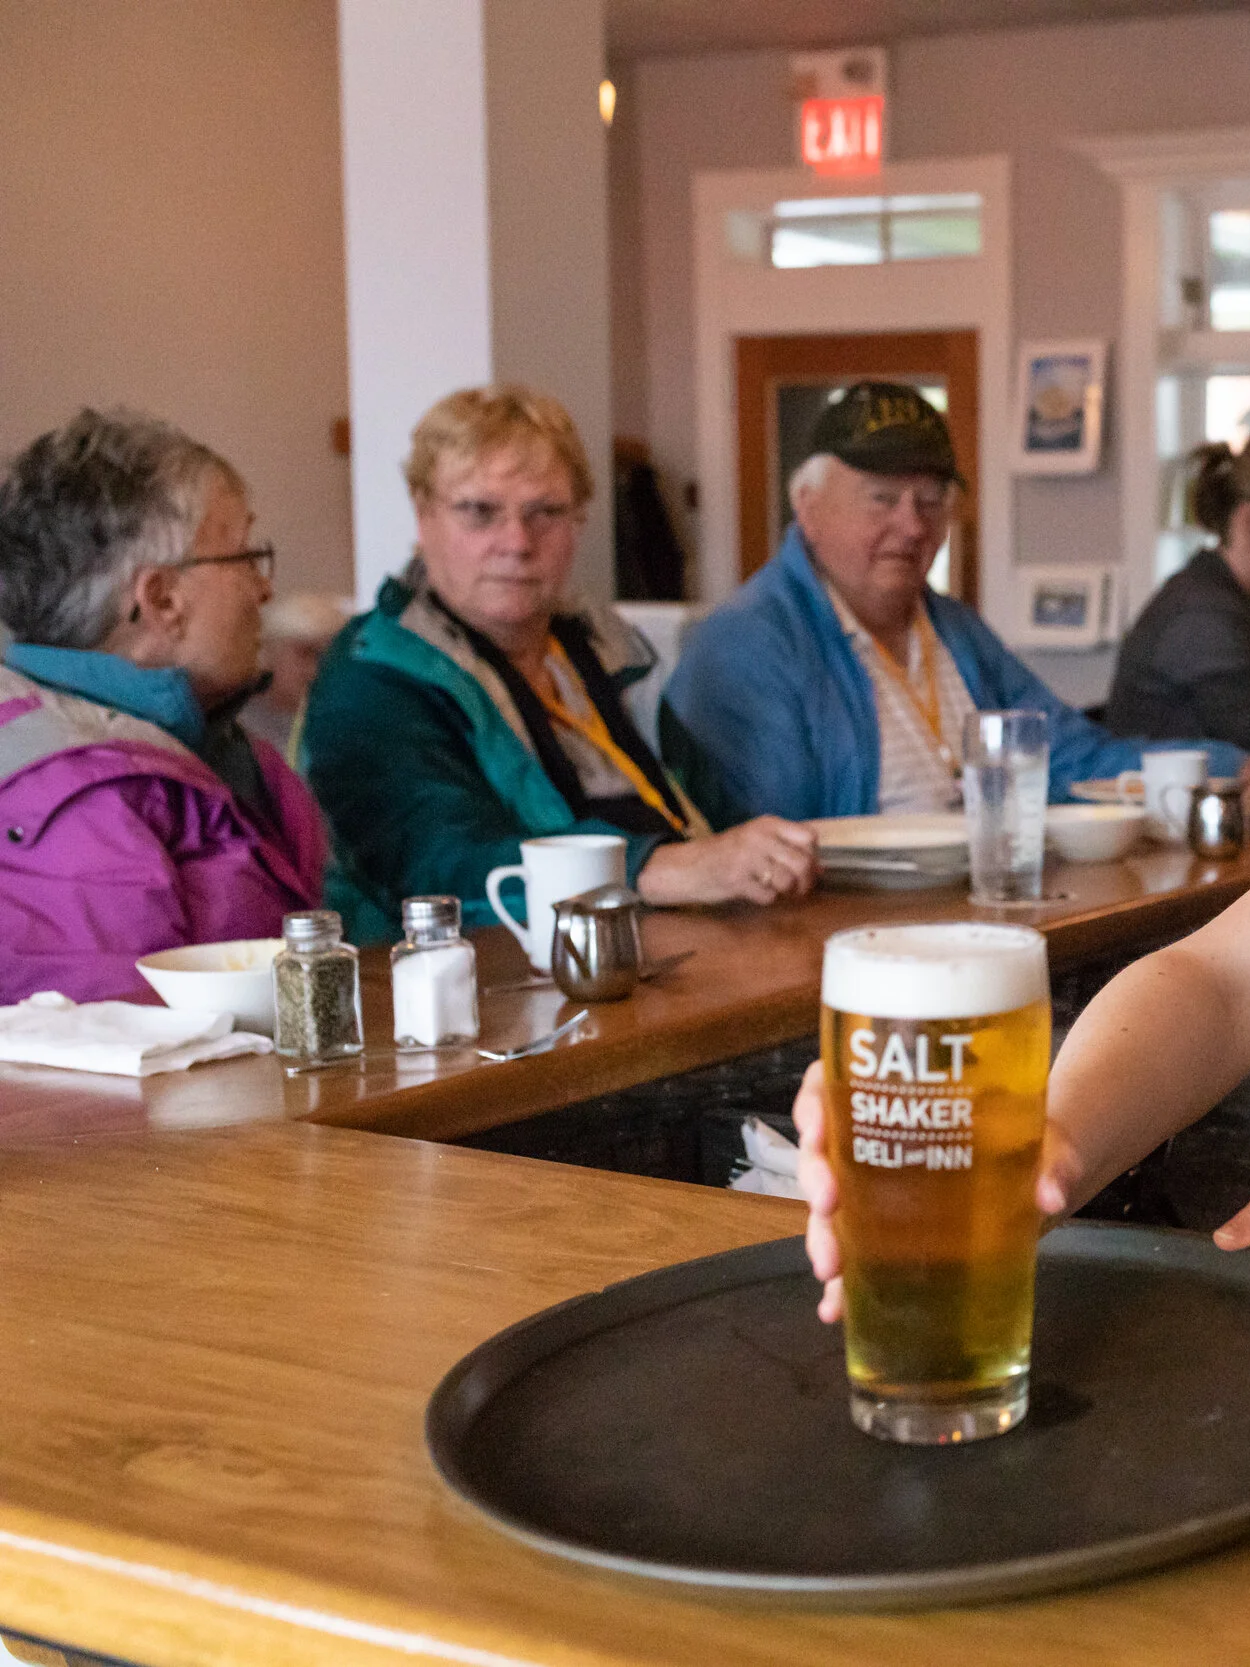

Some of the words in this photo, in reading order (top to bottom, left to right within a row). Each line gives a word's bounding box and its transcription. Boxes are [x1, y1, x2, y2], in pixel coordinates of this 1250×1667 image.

[850, 1028, 973, 1082] SALT
[851, 1091, 973, 1129] SHAKER
[853, 1136, 903, 1169] DELI
[926, 1144, 973, 1171] INN
